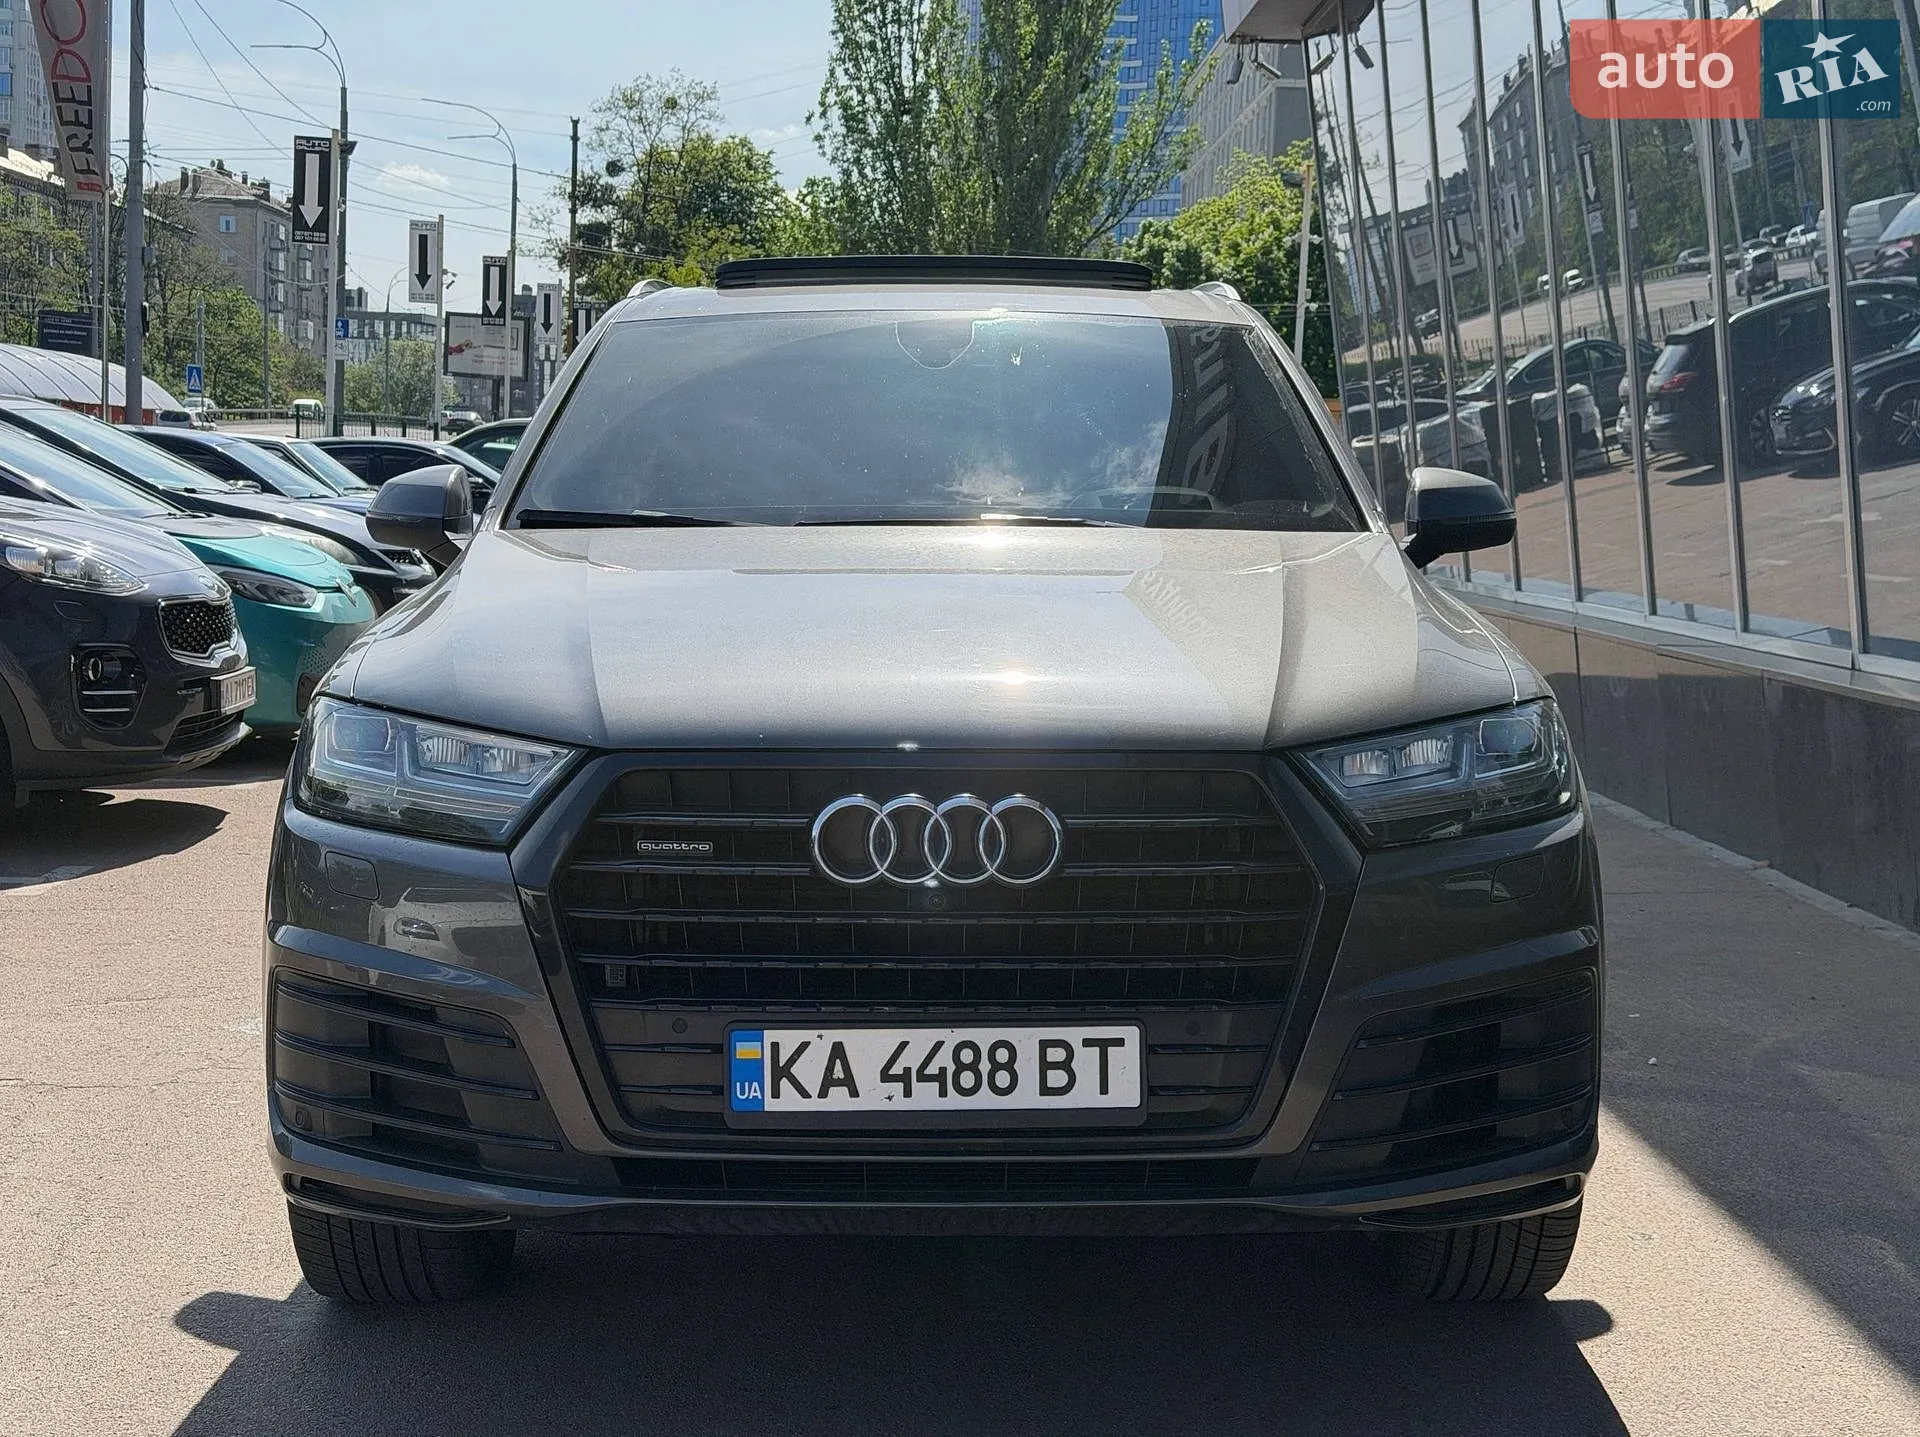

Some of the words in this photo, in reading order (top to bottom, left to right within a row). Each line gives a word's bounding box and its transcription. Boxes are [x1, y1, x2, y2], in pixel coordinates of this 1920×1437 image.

[641, 843, 710, 851] quattro
[769, 1040, 860, 1099] KA
[879, 1039, 1018, 1099] 4488
[1038, 1037, 1125, 1097] BT
[736, 1082, 762, 1099] UA
